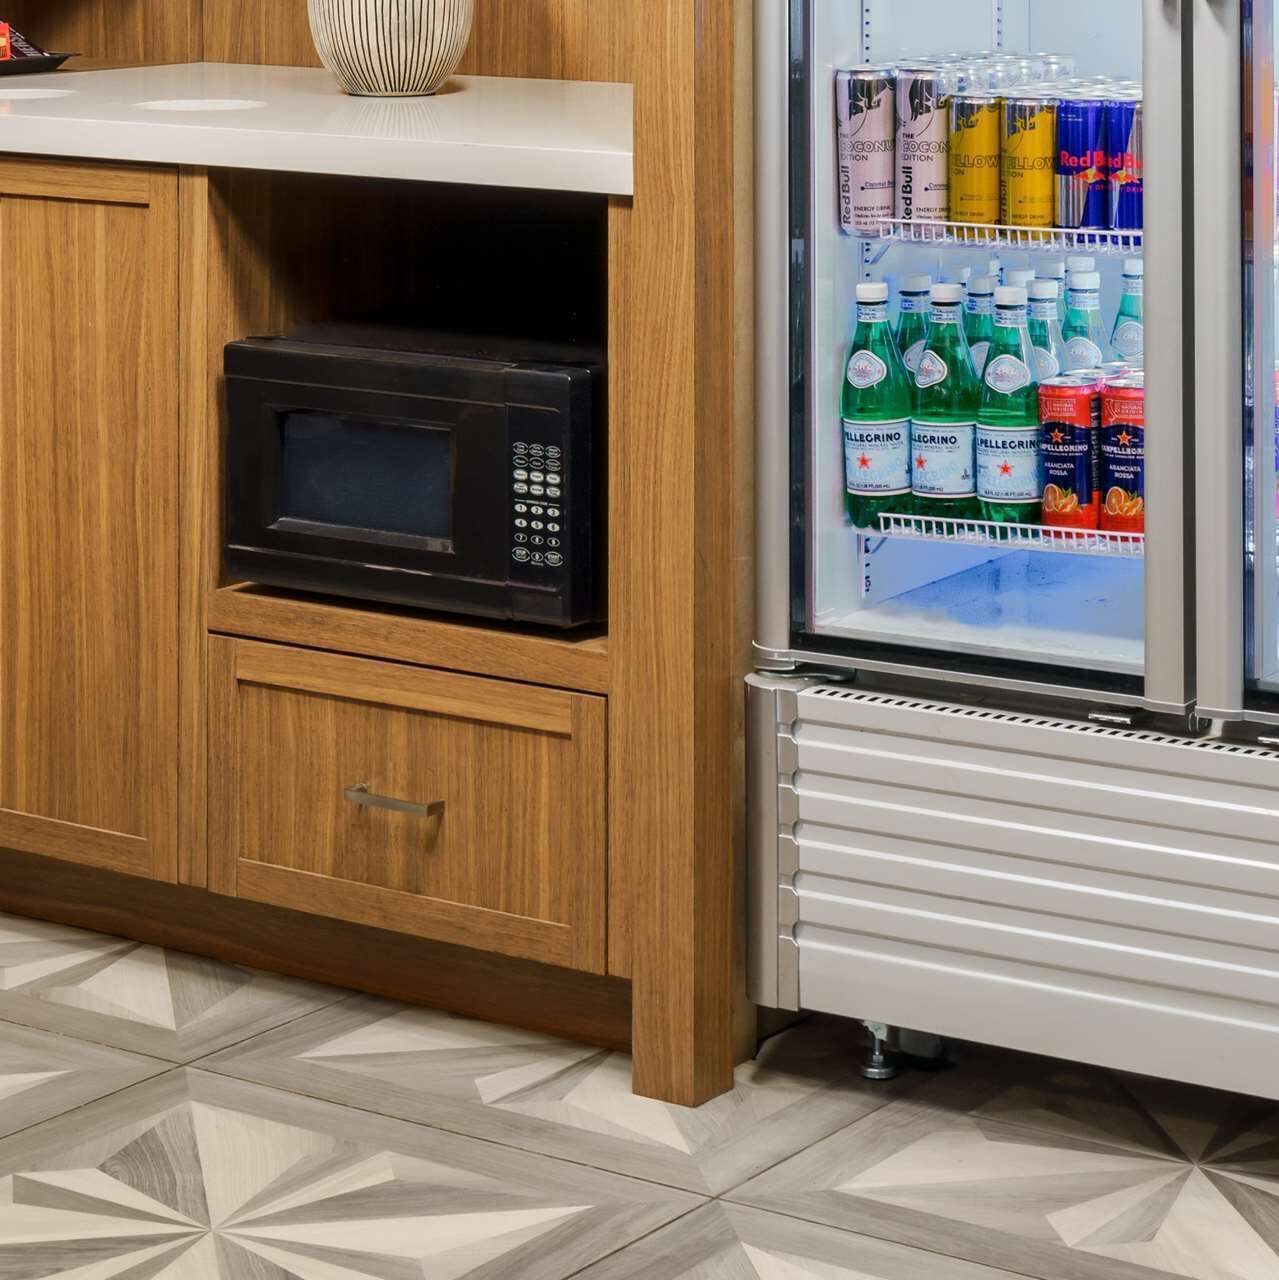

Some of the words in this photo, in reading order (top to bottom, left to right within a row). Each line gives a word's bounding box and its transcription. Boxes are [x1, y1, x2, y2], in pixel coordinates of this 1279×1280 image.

[902, 140, 951, 154] COCON
[954, 154, 1000, 168] ELLOW
[1059, 150, 1091, 168] Red
[840, 165, 850, 193] Bull
[901, 166, 913, 195] Bull
[842, 194, 852, 225] Red
[1108, 463, 1142, 472] ARANCIATA
[1114, 472, 1135, 480] ROSSA
